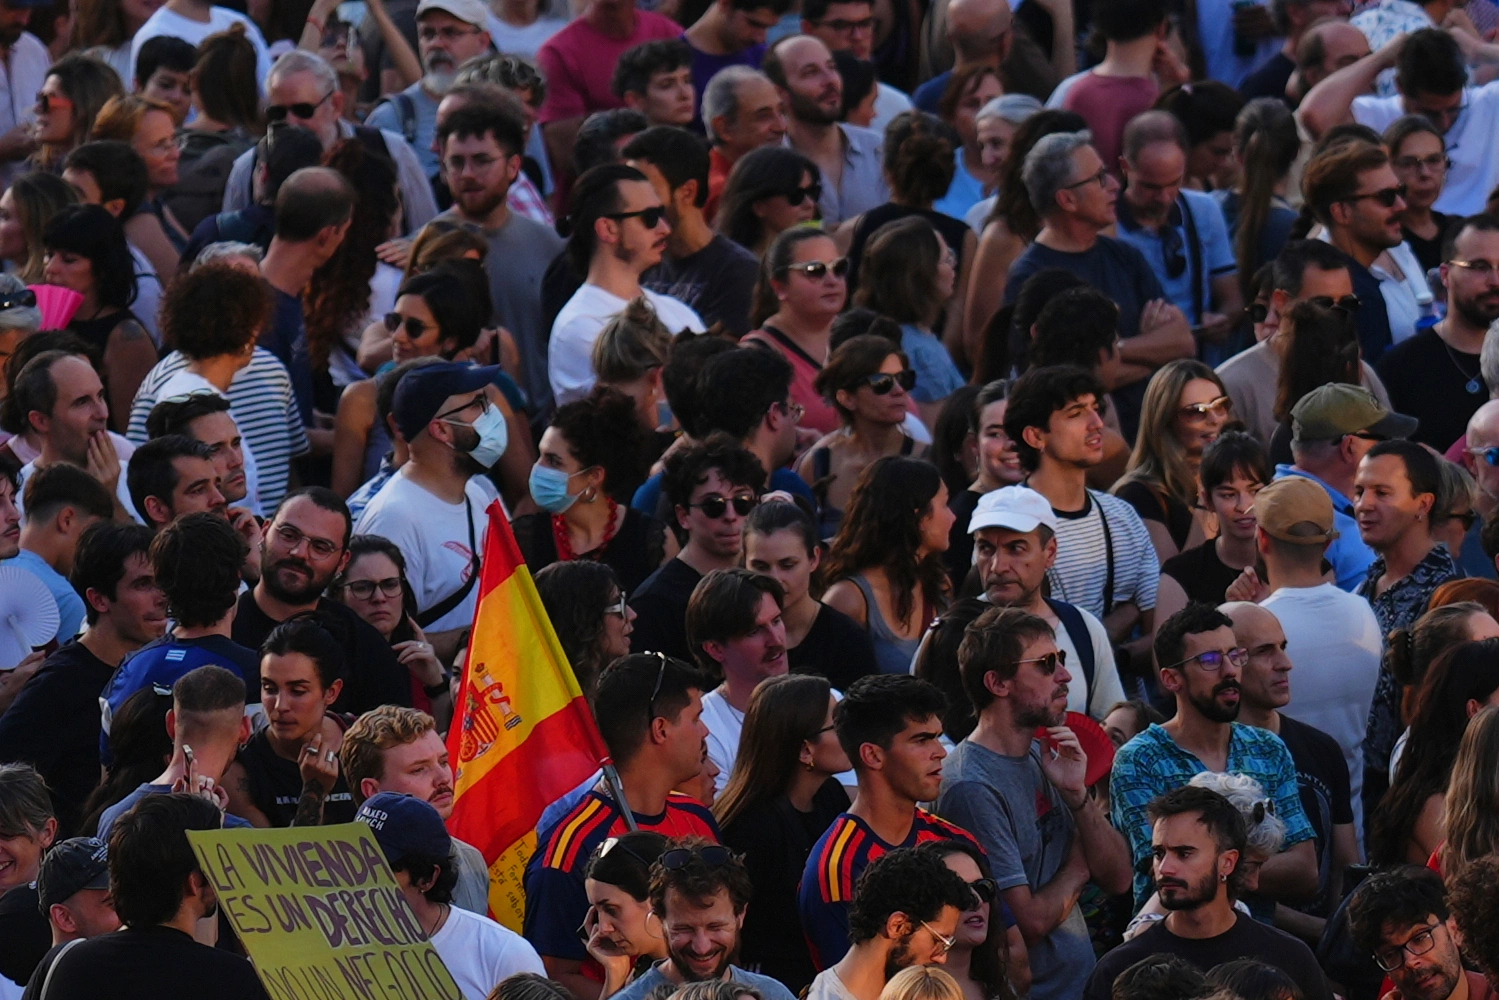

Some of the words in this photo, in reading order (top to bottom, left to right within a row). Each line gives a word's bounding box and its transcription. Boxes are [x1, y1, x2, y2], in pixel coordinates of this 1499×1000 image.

[198, 843, 246, 891] LA
[237, 836, 401, 888] VIVIENDA
[225, 894, 272, 933] ES
[264, 892, 312, 933] UN
[303, 885, 429, 949] DERECHO
